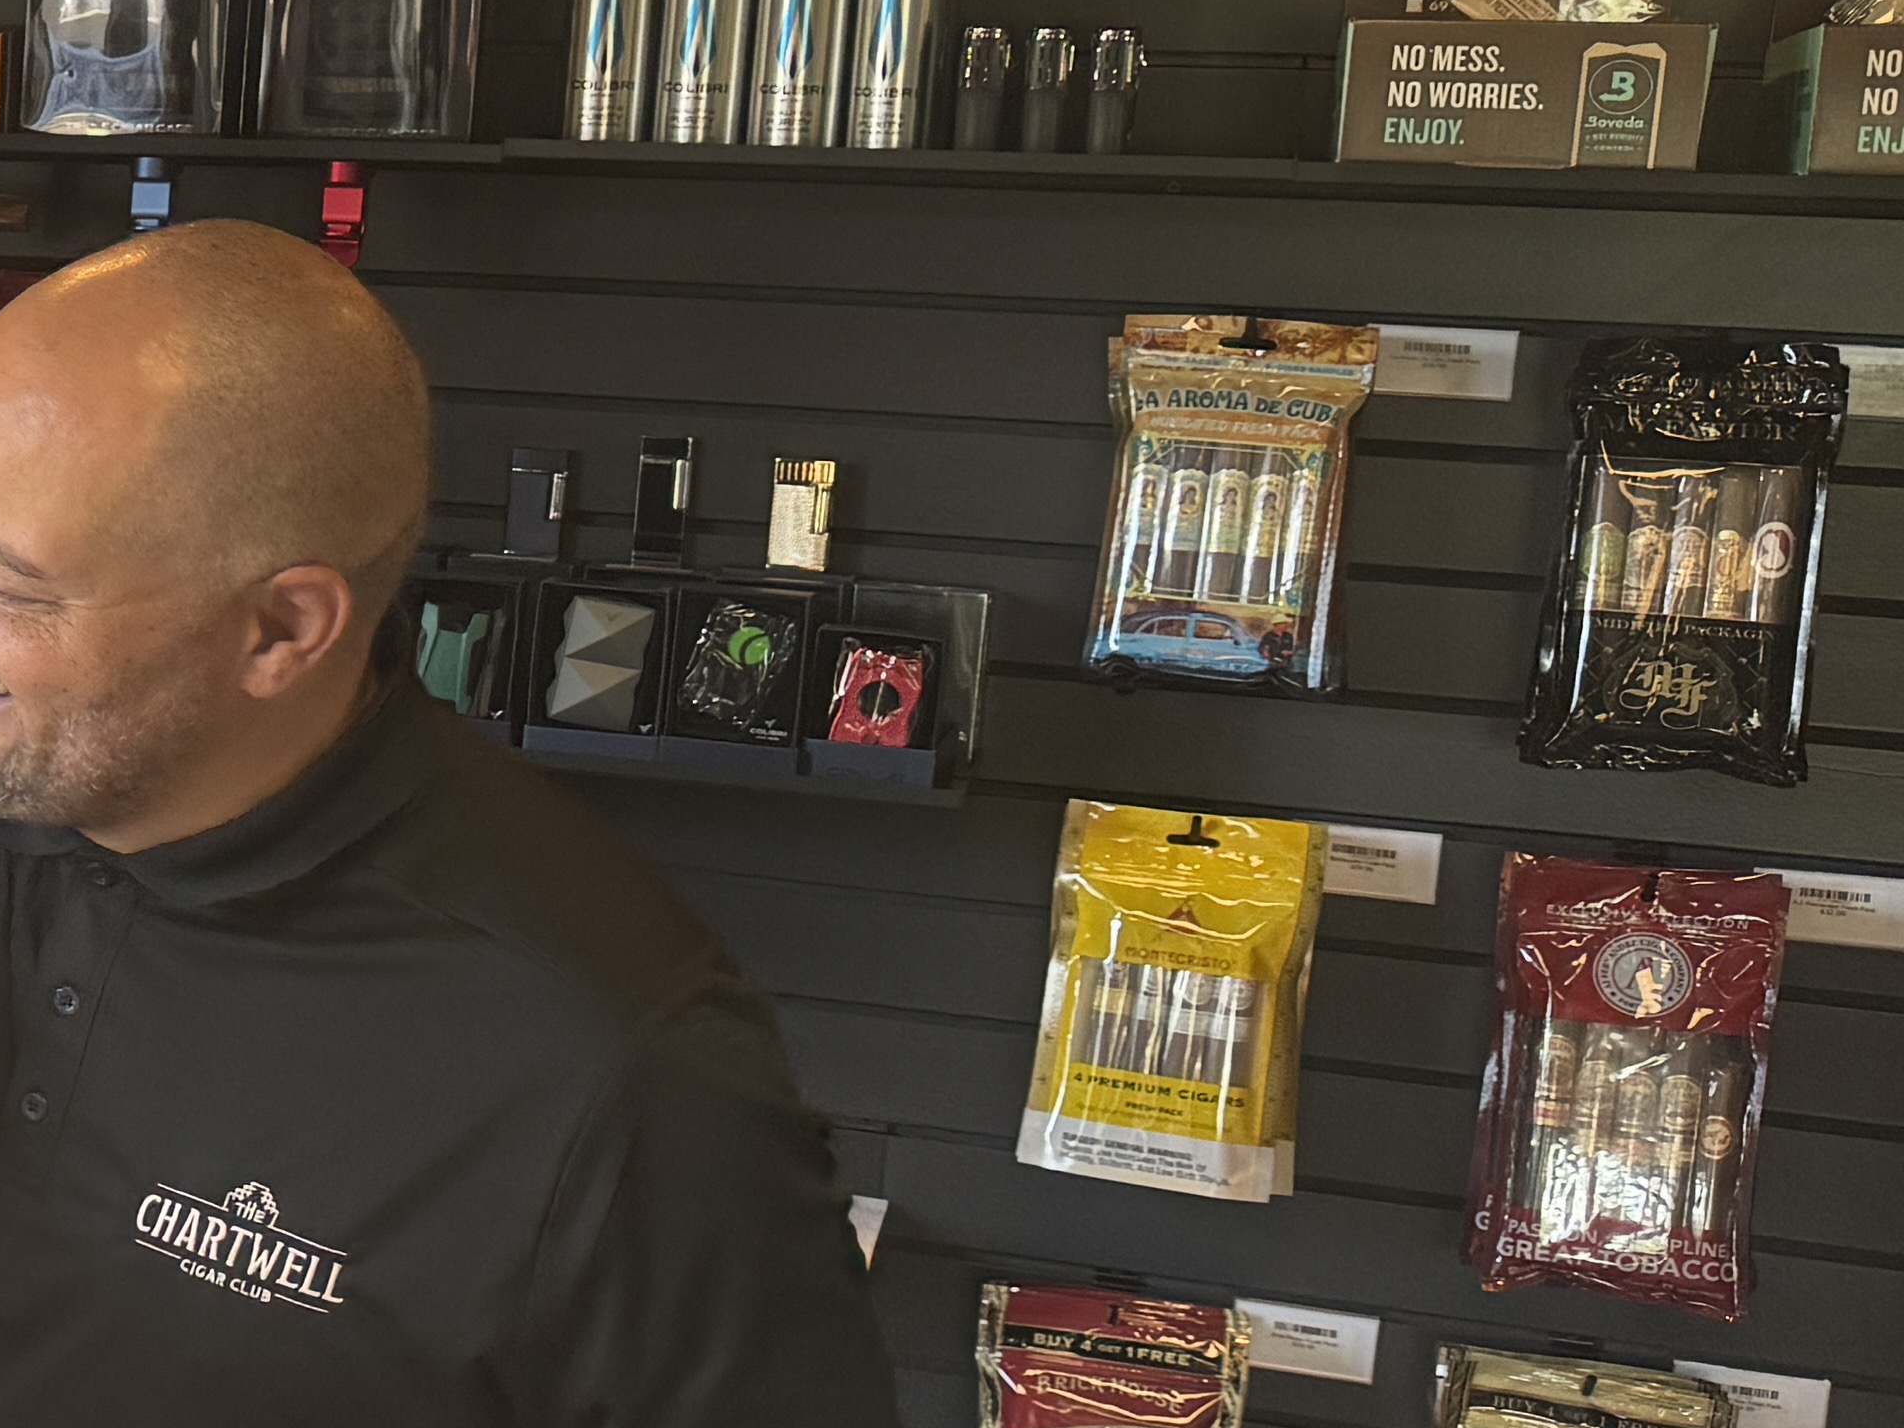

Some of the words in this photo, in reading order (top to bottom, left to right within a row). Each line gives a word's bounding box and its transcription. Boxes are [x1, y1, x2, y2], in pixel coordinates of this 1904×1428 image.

[1392, 44, 1424, 72] NO
[1432, 44, 1505, 73] MESS.
[1866, 49, 1903, 78] NO
[1388, 81, 1421, 109] NO
[1429, 81, 1544, 112] WORRIES.
[1862, 87, 1899, 116] NO
[1384, 118, 1465, 146] ENJOY.
[1584, 115, 1644, 129] Boveda
[1166, 389, 1249, 412] AROMA
[1255, 398, 1280, 416] DE
[1286, 399, 1347, 426] CUBA
[1073, 1073, 1083, 1082] 4
[1087, 1075, 1171, 1097] PREMIUM
[1178, 1089, 1246, 1108] CIGARS
[1125, 1101, 1155, 1112] FRESH
[1159, 1106, 1184, 1117] PACK
[235, 1201, 266, 1224] THE
[135, 1193, 345, 1305] CHARTWELL
[1497, 1237, 1594, 1264] GREAT
[1597, 1249, 1735, 1283] TOBACCO
[179, 1257, 226, 1288] CIGAR
[229, 1276, 273, 1304] CLUB
[1032, 1332, 1074, 1349] BUY
[1080, 1339, 1092, 1353] 4
[1097, 1343, 1122, 1355] GET
[1125, 1346, 1134, 1359] 1
[1136, 1347, 1191, 1367] FREE
[1037, 1374, 1104, 1395] BRICK
[1493, 1394, 1538, 1413] BUY
[1545, 1405, 1554, 1418] 4
